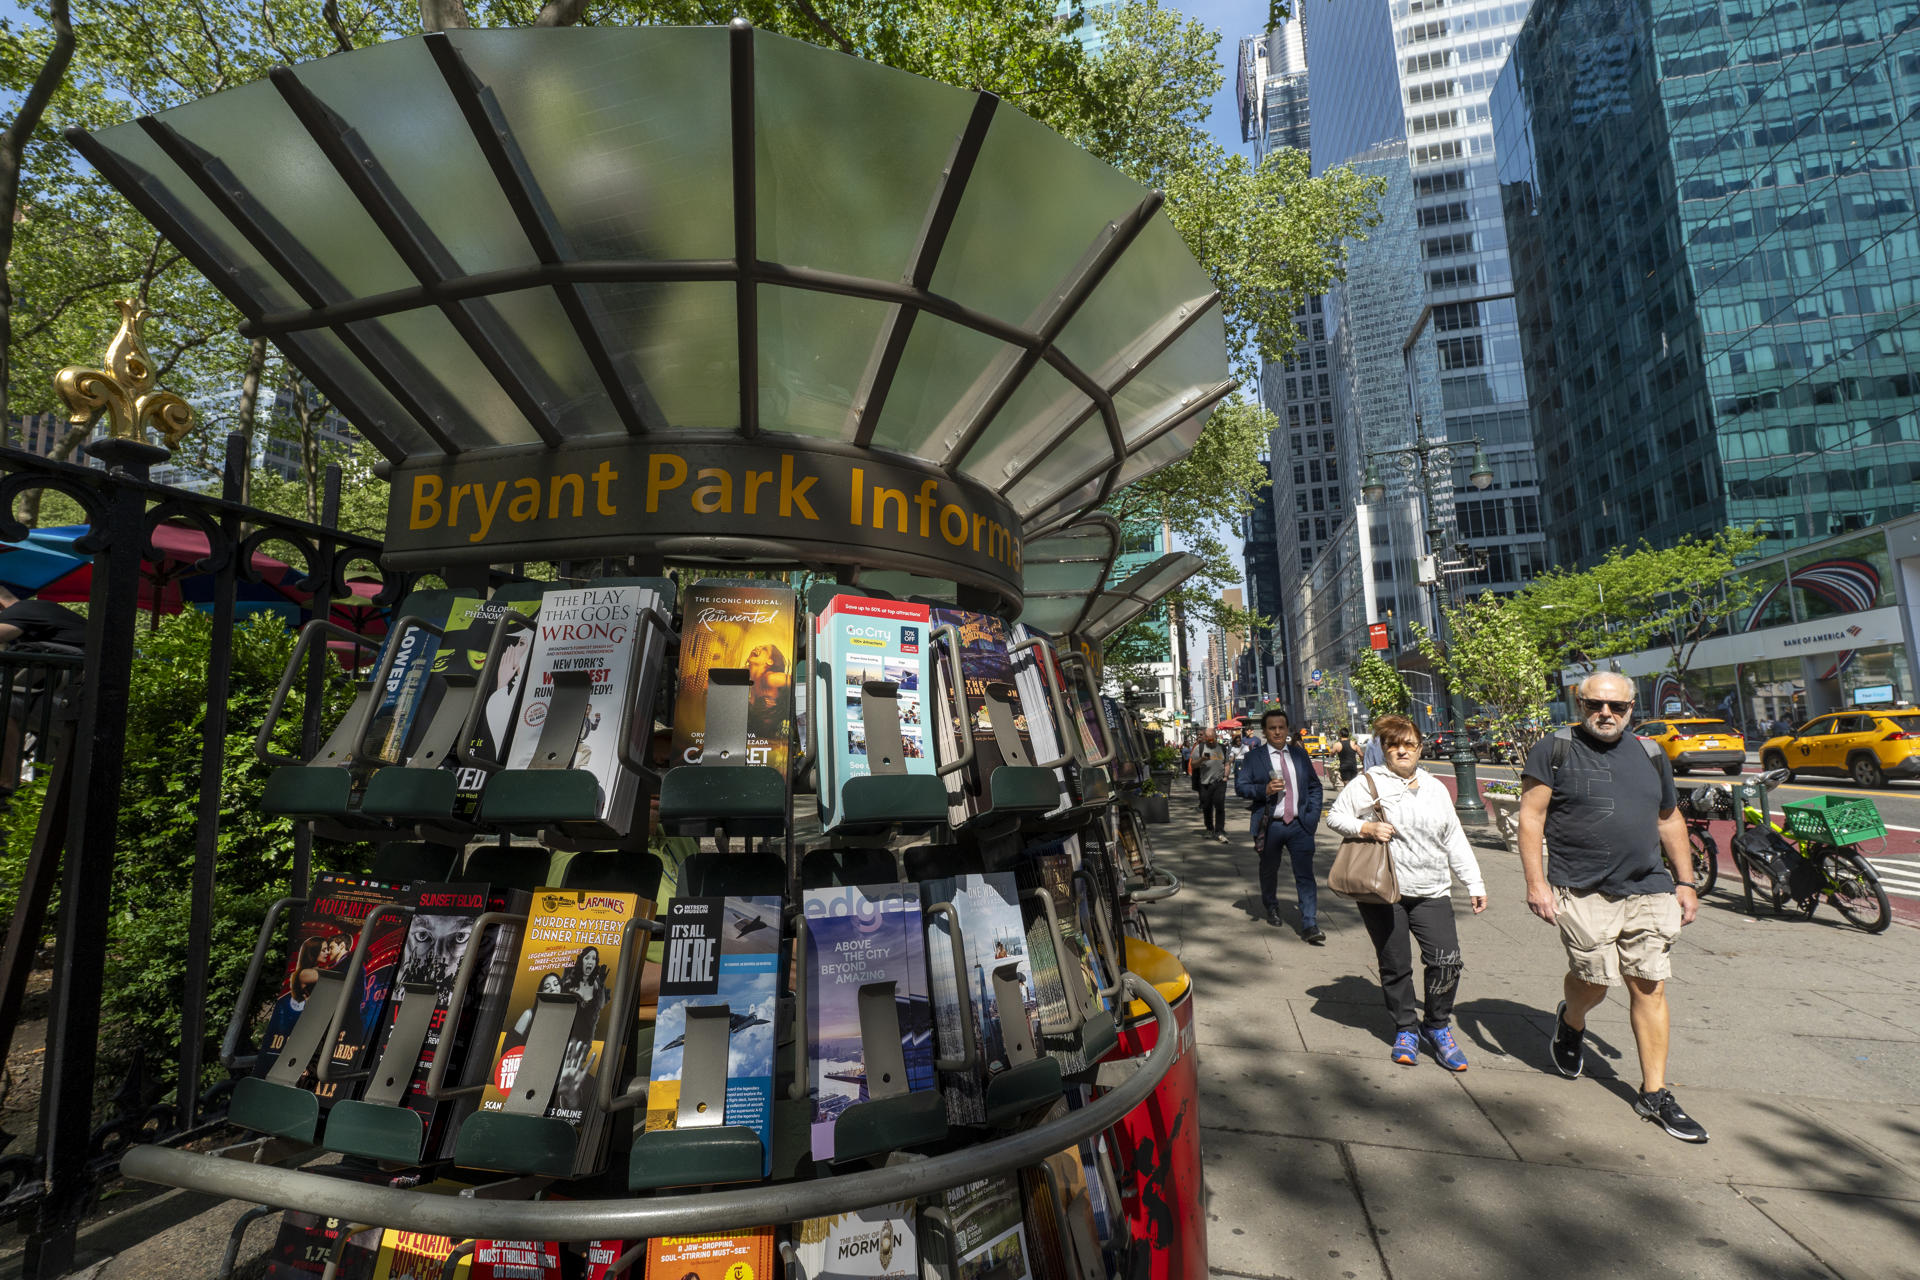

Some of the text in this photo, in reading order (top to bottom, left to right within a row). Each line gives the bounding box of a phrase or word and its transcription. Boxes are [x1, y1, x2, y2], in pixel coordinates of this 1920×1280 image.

[408, 460, 618, 542] Bryant
[645, 453, 821, 520] Park
[554, 590, 625, 607] THE PLAY
[545, 605, 631, 622] THAT GOES
[542, 622, 627, 644] WRONG
[1783, 631, 1846, 647] BANK OF AMERICA
[553, 657, 604, 670] NEW YORK'S
[420, 893, 458, 907] SUNSET
[313, 897, 363, 919] MOULIN
[804, 885, 904, 932] edge
[534, 916, 625, 932] MURDER MYSTERY
[671, 924, 706, 938] IT'S ALL
[531, 929, 621, 946] DINNER THEATER
[834, 940, 872, 952] ABOVE
[667, 938, 716, 983] HERE
[843, 948, 890, 962] THE CITY
[821, 961, 866, 975] BEYOND
[836, 969, 886, 984] AMAZING
[484, 1101, 502, 1110] SCAN
[556, 1108, 583, 1119] ONLINE
[946, 1185, 966, 1205] PARK
[840, 1236, 851, 1245] THE
[852, 1233, 870, 1242] BOOK
[478, 1249, 557, 1269] MOST THRILLING NIGHT
[660, 1251, 711, 1263] SOUL-STIRRING
[493, 1264, 504, 1279] ON
